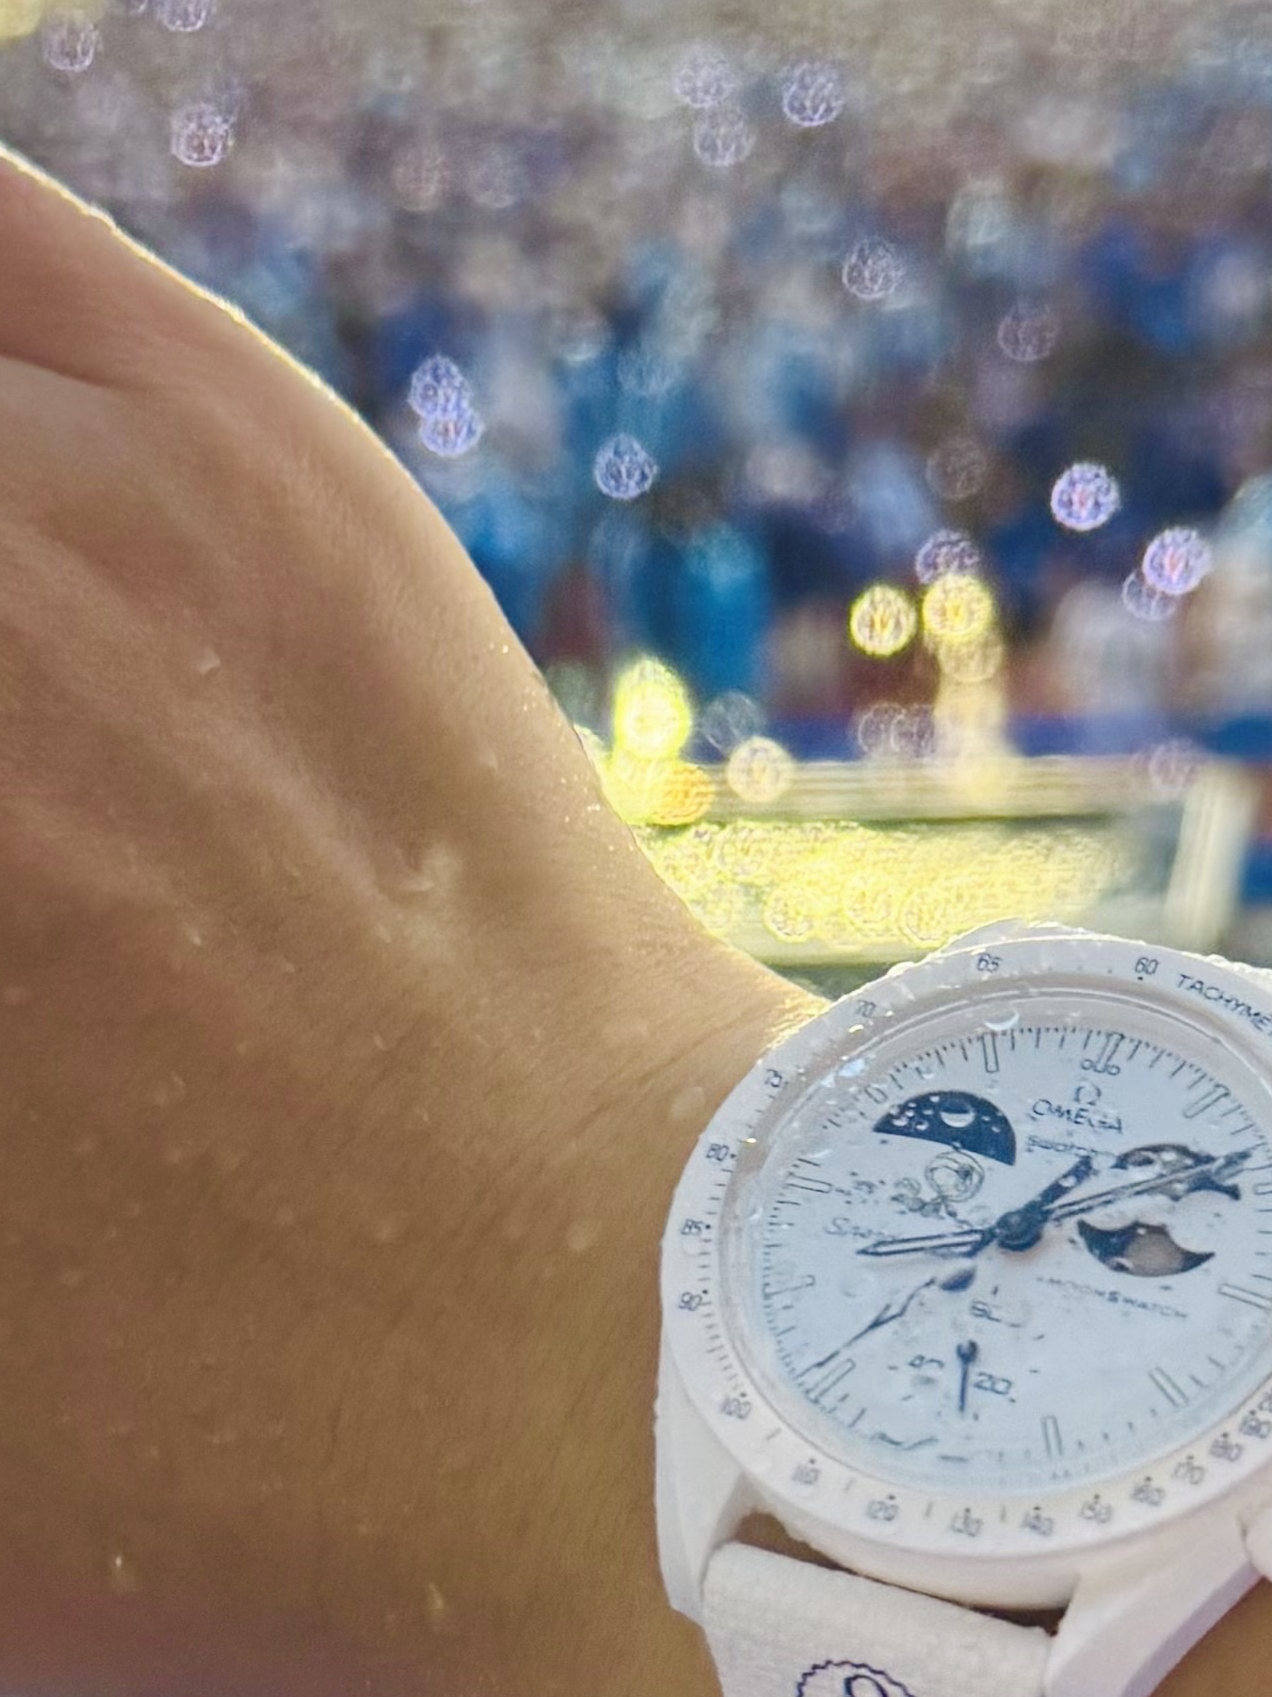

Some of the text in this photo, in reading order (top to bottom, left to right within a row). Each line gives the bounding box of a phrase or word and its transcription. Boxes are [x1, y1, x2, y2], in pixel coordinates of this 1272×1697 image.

[977, 953, 1002, 973] 65
[1134, 957, 1159, 976] 60
[1031, 1099, 1123, 1133] OMEGA
[705, 1143, 729, 1162] 80
[681, 1219, 704, 1236] 85
[679, 1291, 703, 1312] 90
[973, 1371, 1013, 1396] 20
